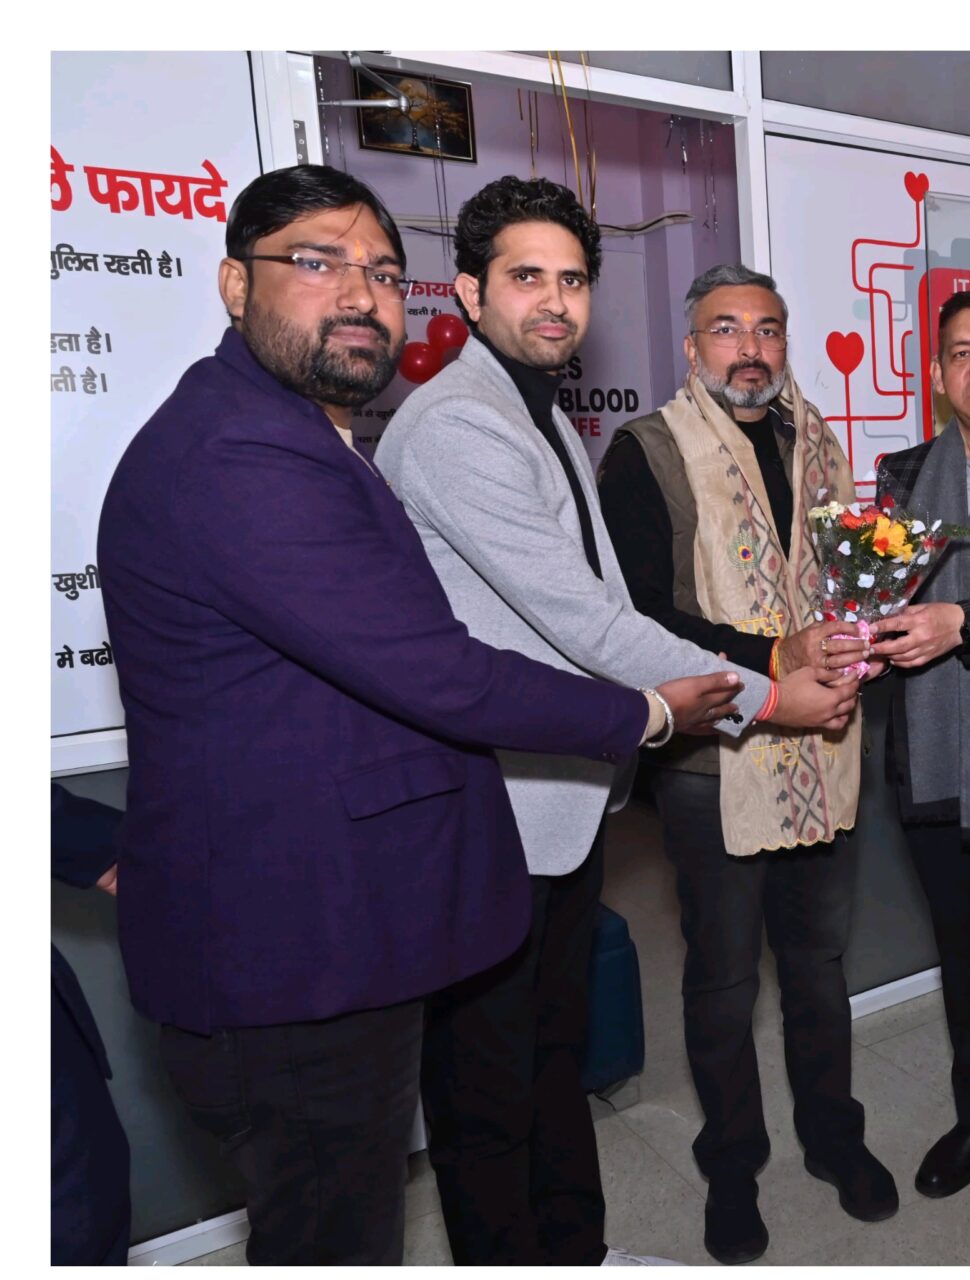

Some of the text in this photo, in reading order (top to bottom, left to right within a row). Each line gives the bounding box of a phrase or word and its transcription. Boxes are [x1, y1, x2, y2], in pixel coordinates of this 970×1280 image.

[83, 159, 228, 222] फायदे
[103, 249, 152, 276] रहती
[558, 387, 640, 413] BLOOD
